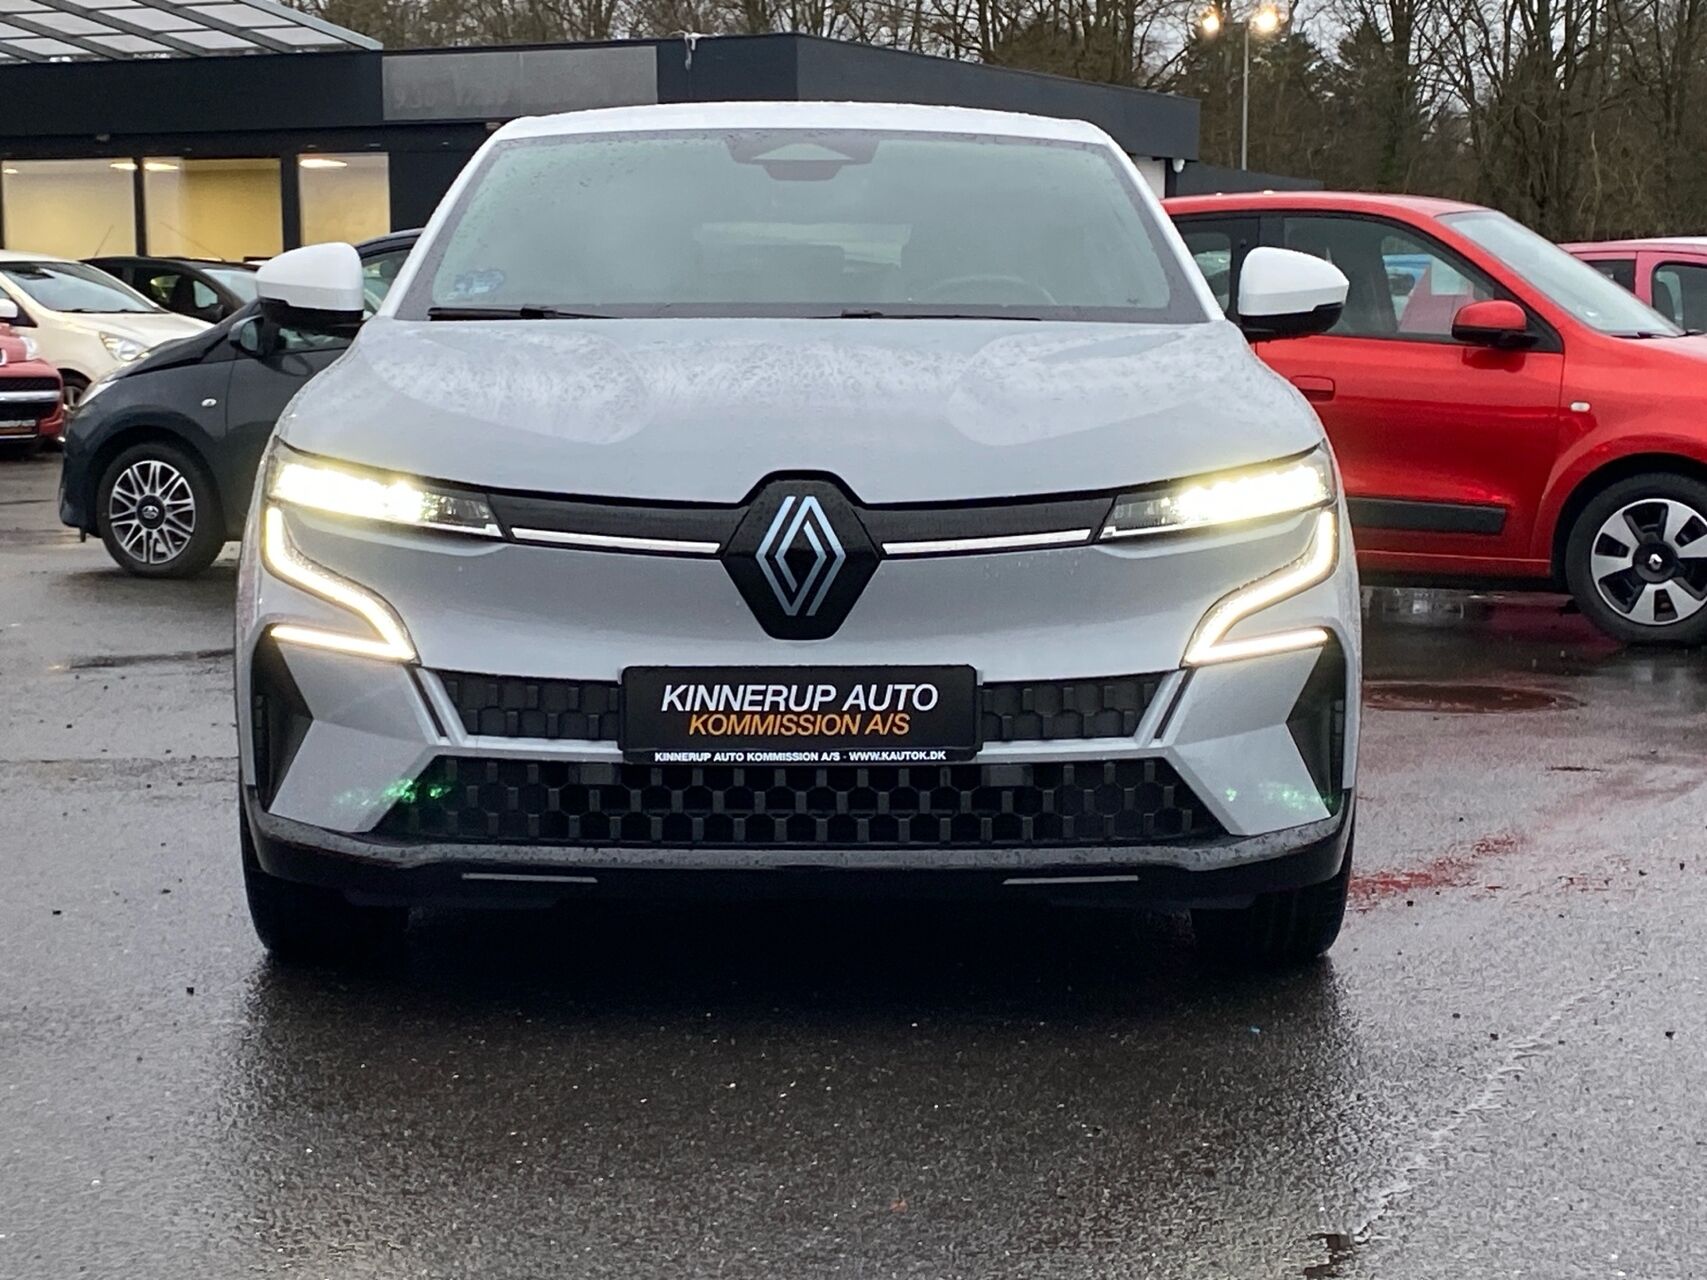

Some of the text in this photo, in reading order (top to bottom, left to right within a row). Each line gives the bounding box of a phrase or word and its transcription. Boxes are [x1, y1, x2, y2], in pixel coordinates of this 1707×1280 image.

[661, 684, 938, 712] KINNERUP AUTO
[688, 713, 911, 736] KOMMISSION A/S
[654, 752, 711, 762] KINNERUP
[713, 752, 744, 762] AUTO
[747, 752, 819, 762] KOMMISSION
[821, 751, 841, 761] A/S
[849, 751, 946, 761] WWW.KAUTOK.DK
